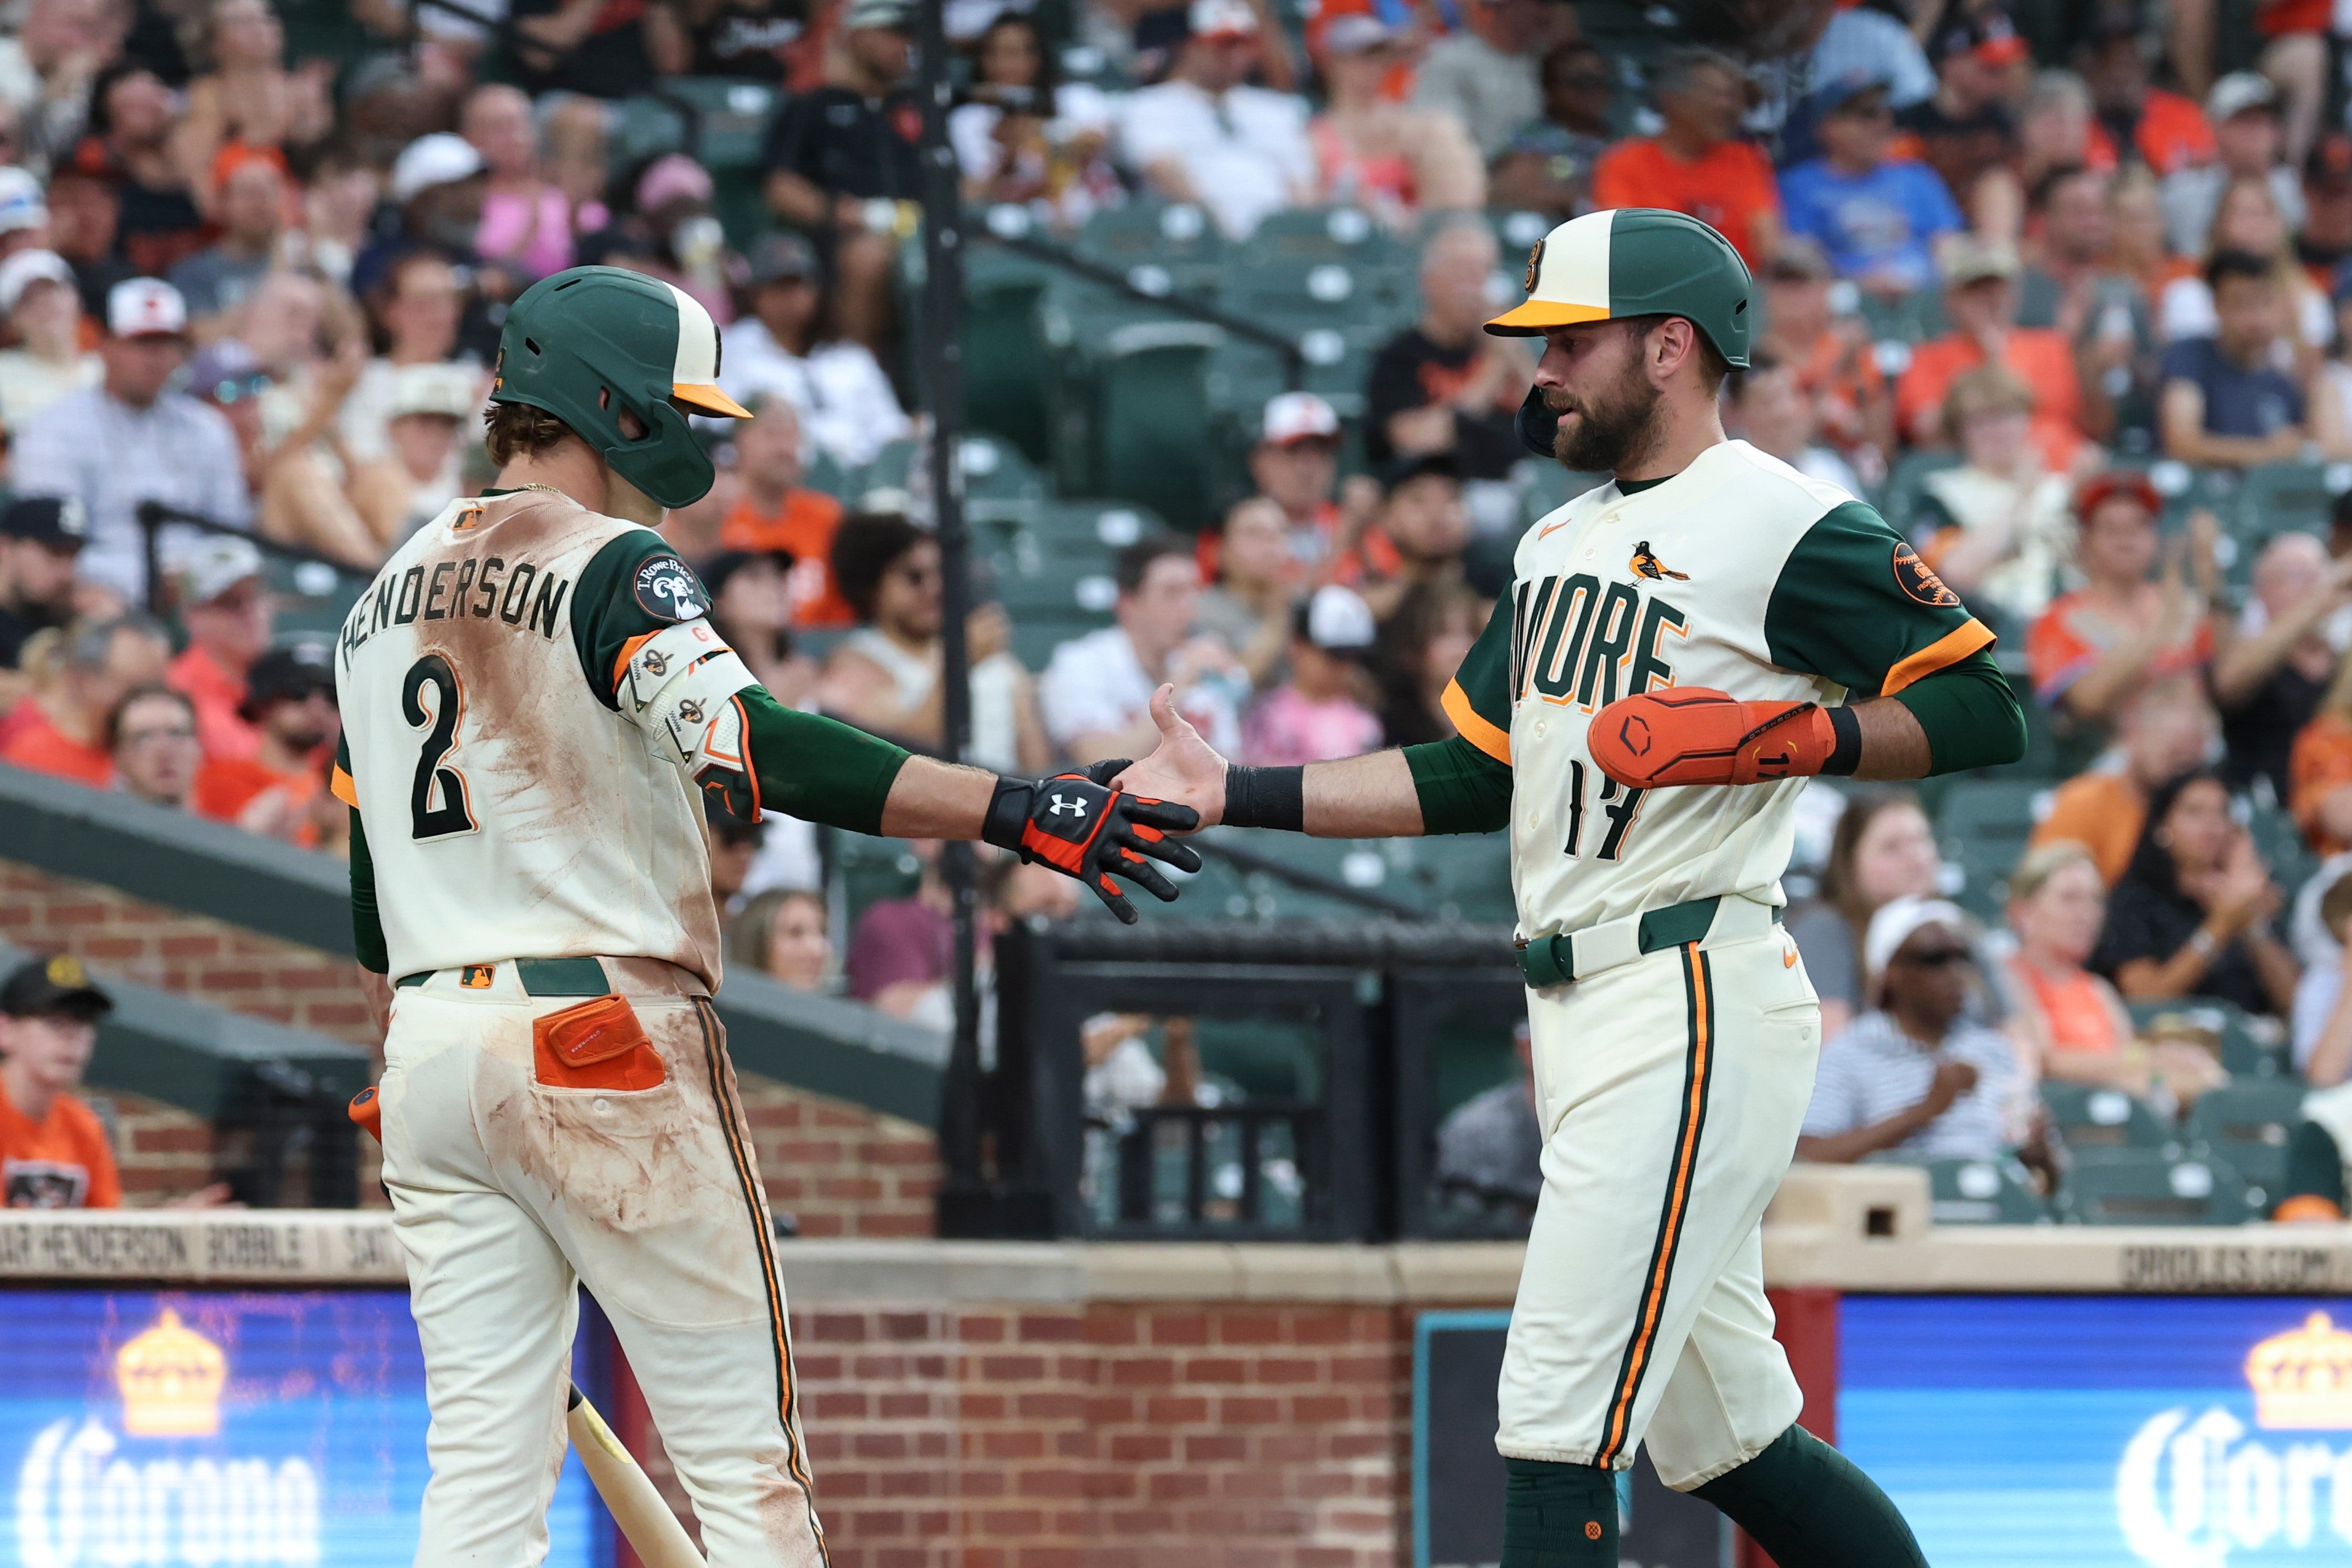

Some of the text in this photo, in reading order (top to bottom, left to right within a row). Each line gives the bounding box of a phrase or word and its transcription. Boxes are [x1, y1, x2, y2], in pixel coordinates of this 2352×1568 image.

[342, 557, 569, 674] HENDERSON
[402, 650, 481, 842] 2
[16, 1416, 320, 1568] Corona
